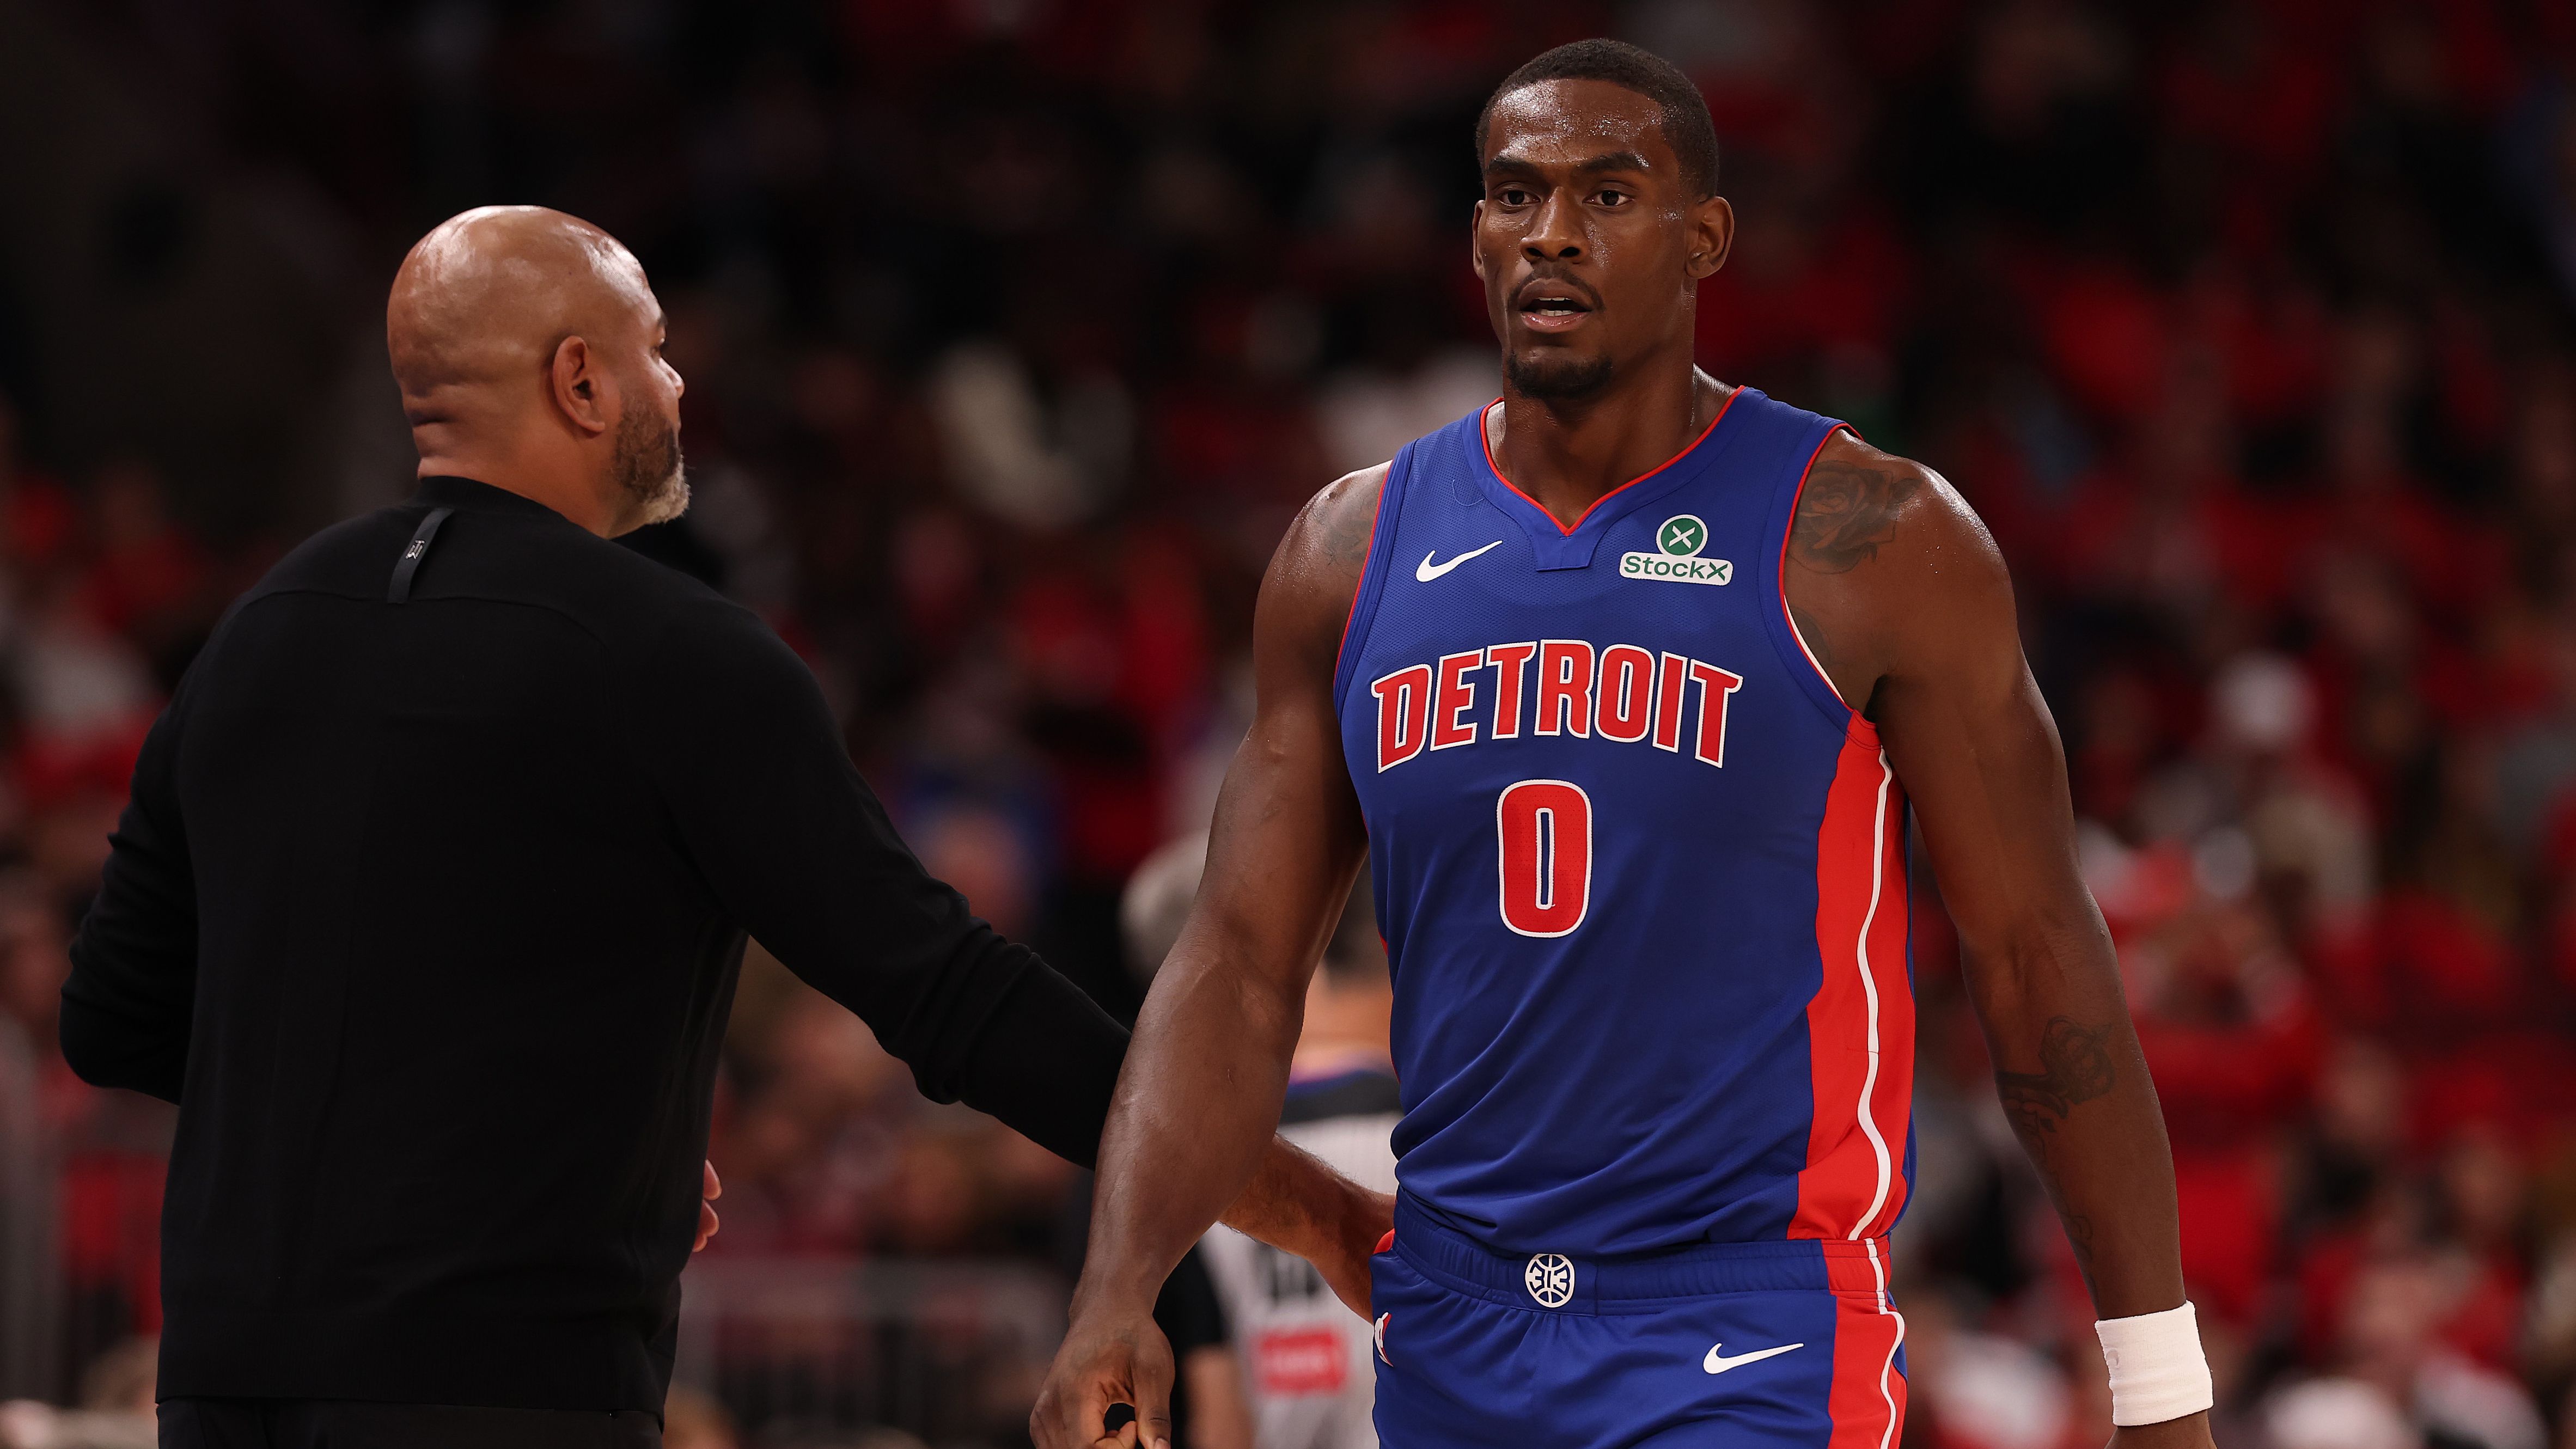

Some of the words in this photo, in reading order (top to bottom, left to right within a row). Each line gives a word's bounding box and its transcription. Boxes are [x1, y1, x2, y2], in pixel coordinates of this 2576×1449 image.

[1624, 555, 1728, 582] StockX
[1371, 639, 1743, 774] DETROIT
[1496, 779, 1592, 938] 0
